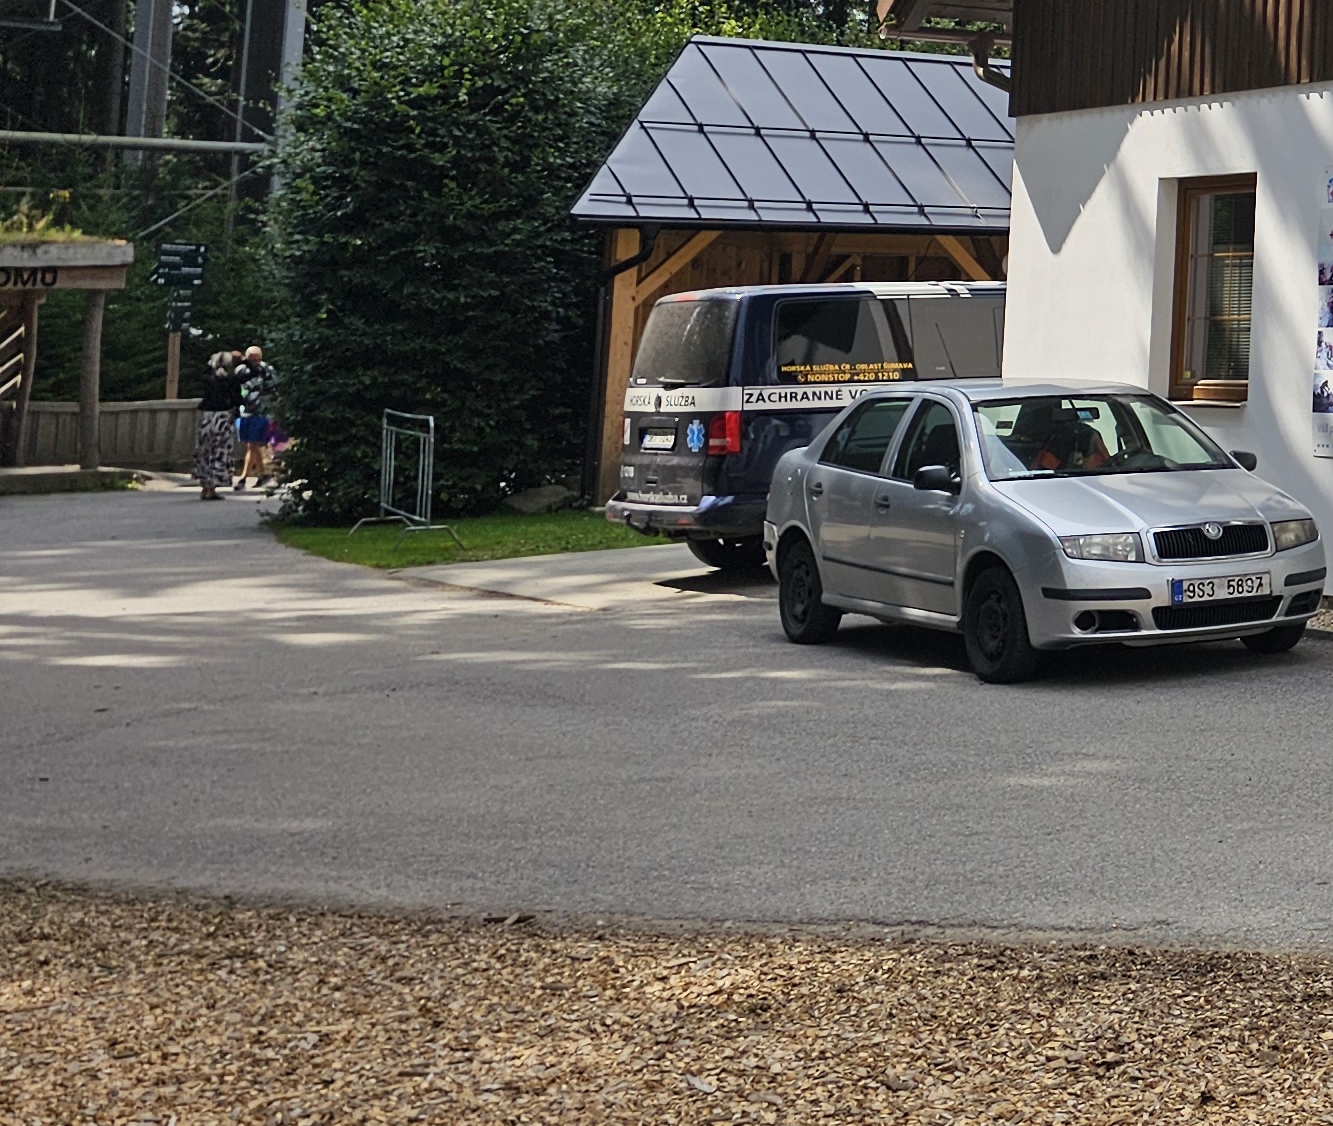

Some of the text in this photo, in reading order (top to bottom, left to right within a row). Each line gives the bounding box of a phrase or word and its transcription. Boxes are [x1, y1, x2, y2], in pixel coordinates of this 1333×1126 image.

[781, 364, 811, 372] HORSKÁ
[812, 363, 839, 371] SLUŽBA
[807, 372, 899, 382] NONSTOP +420 1210
[665, 393, 696, 407] SLUŽBA
[744, 388, 843, 404] ZÁCHRANNÉ
[1187, 581, 1215, 599] 9S3
